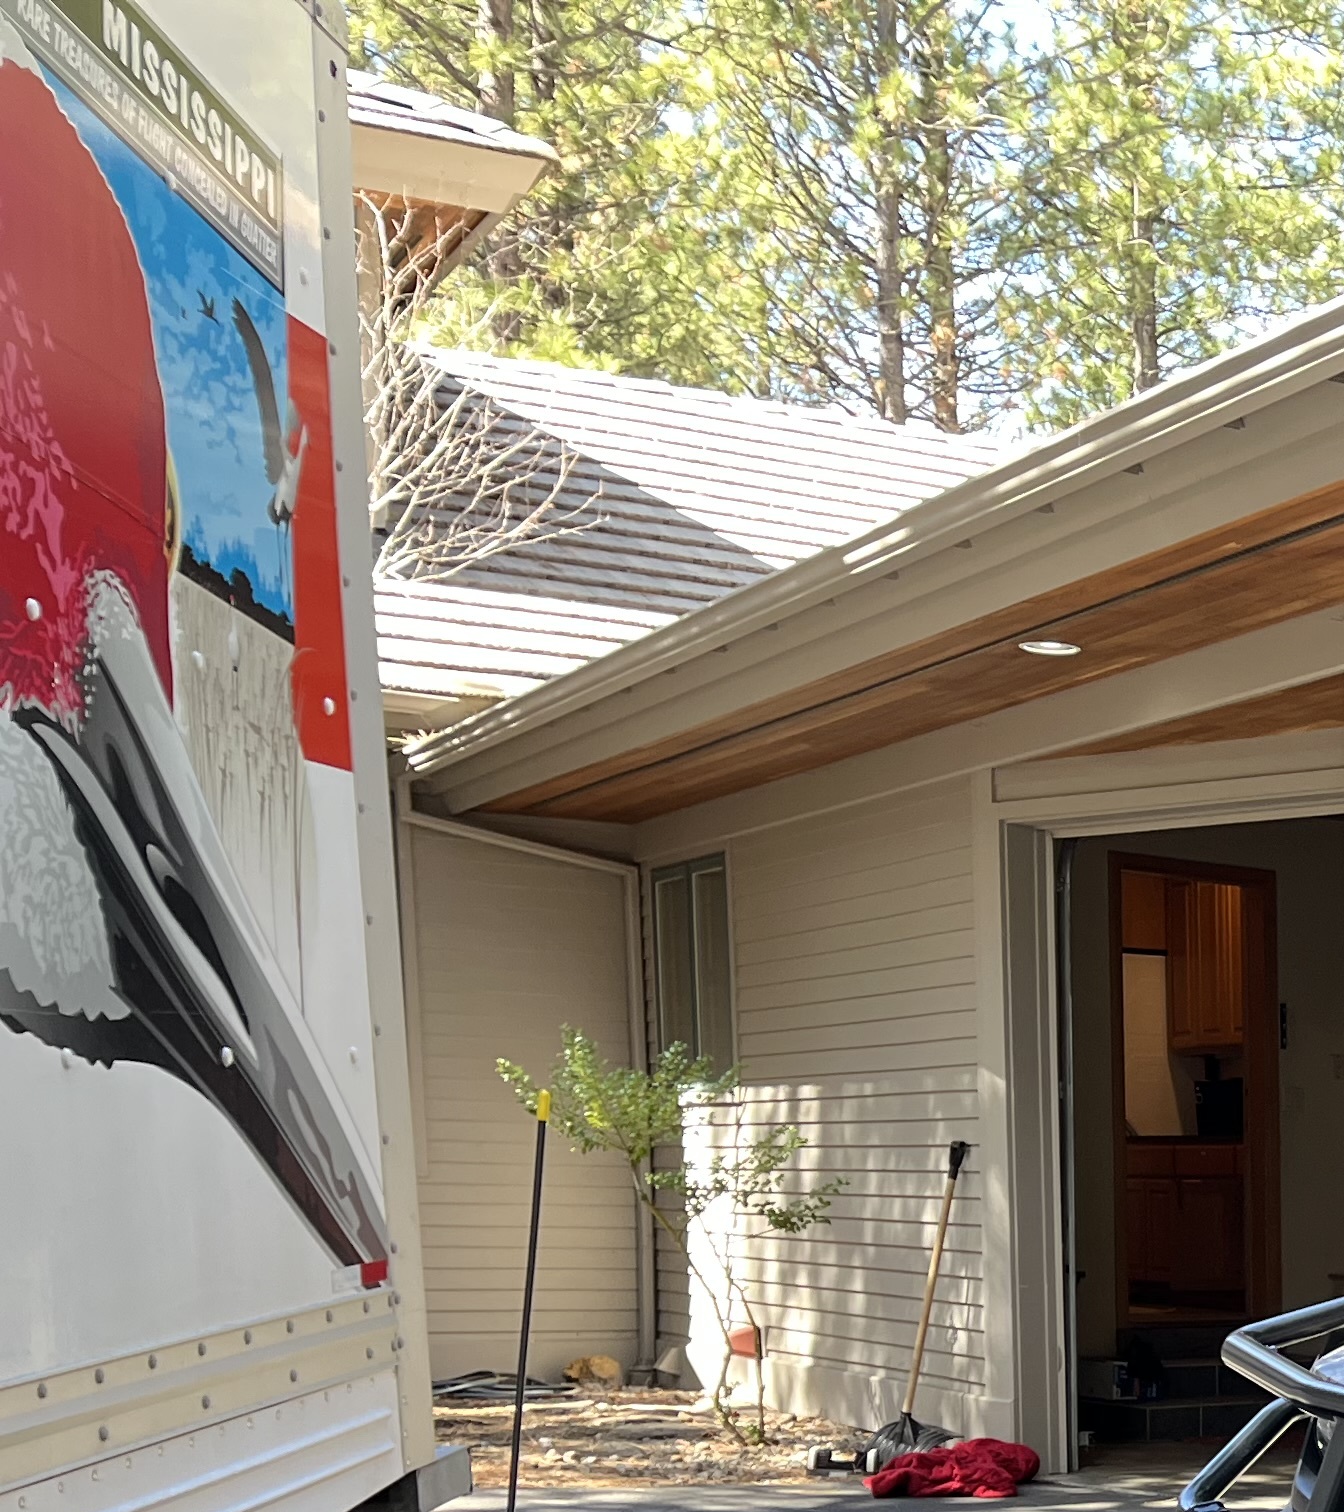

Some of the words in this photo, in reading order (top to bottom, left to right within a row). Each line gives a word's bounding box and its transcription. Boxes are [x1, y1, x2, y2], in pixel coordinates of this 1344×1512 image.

[16, 0, 51, 44] RARE
[53, 22, 119, 110] TREASURES
[121, 92, 137, 125] OF
[138, 106, 174, 163] FLIGHT
[174, 145, 227, 216] CONCEALED
[103, 0, 276, 219] MISSISSIPPI
